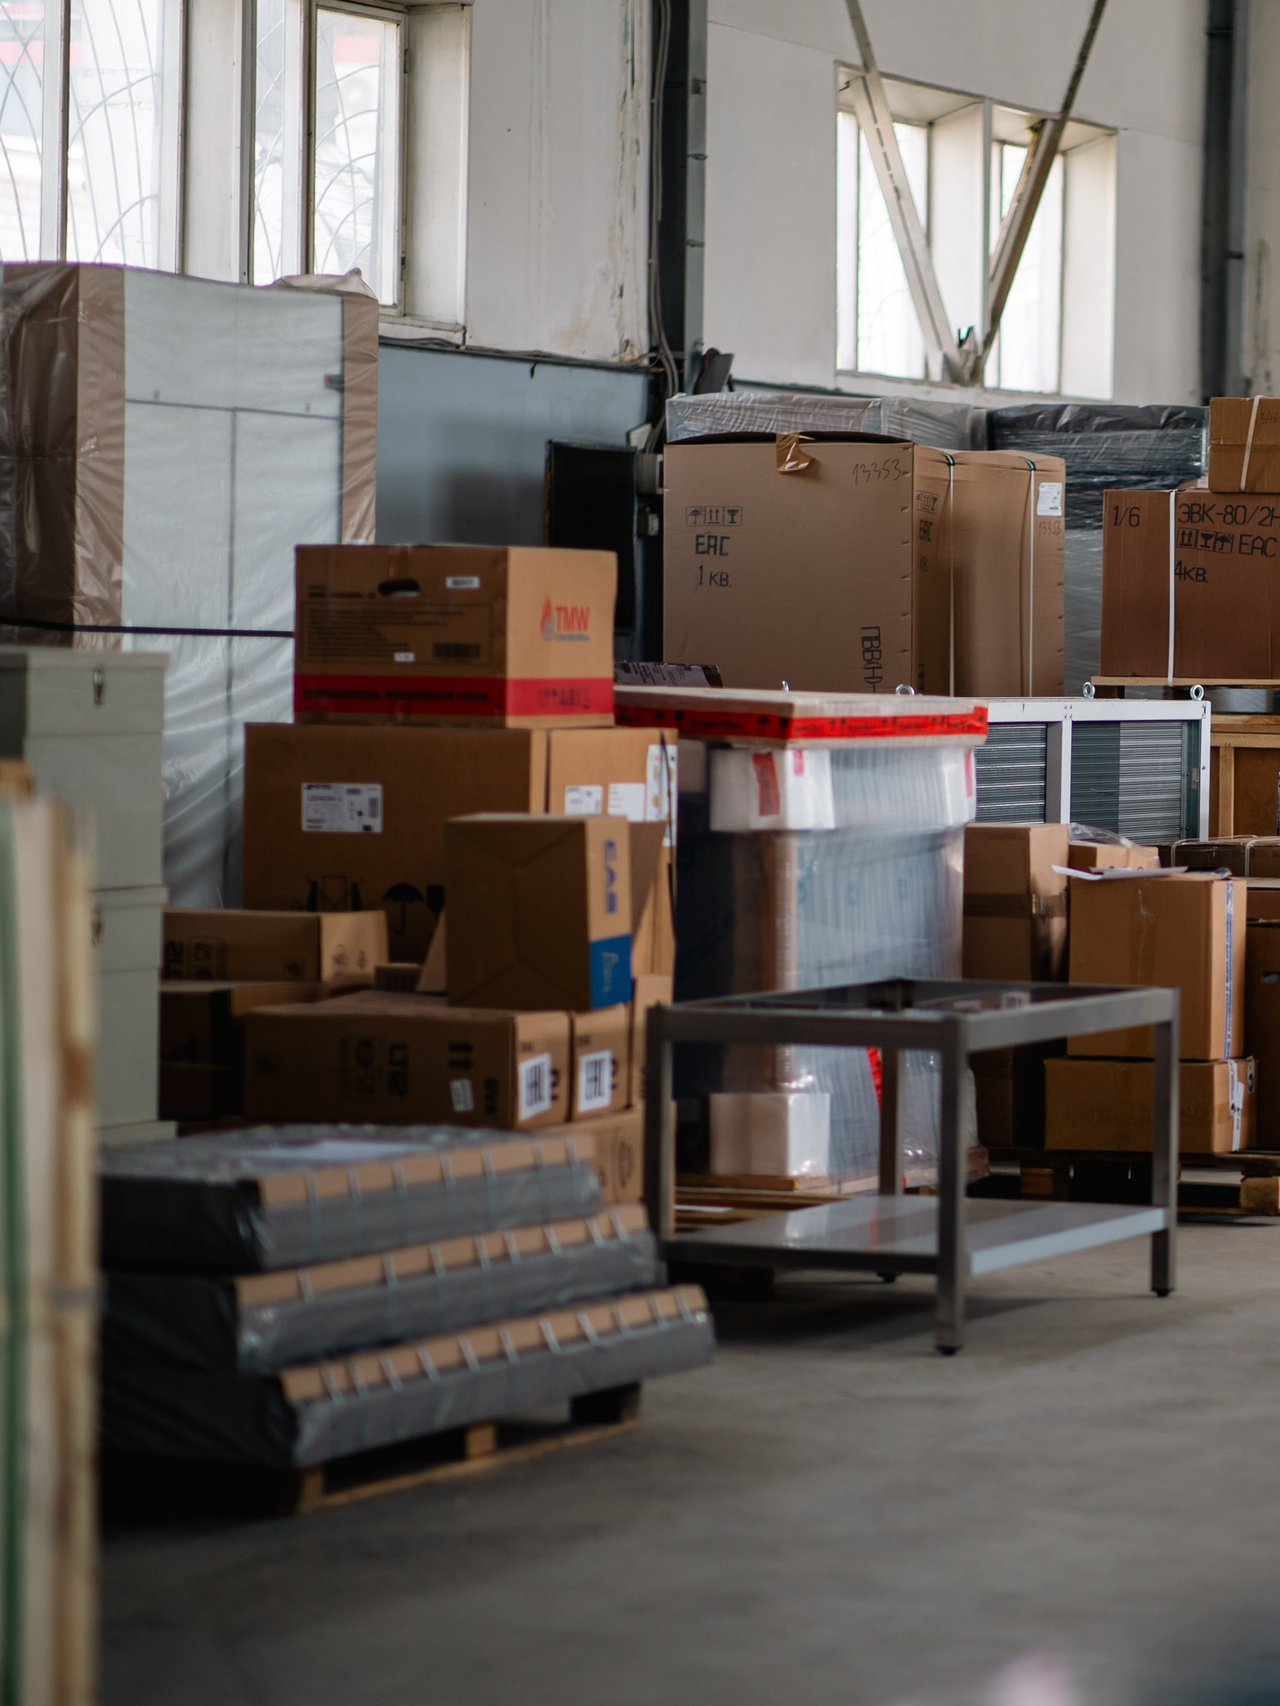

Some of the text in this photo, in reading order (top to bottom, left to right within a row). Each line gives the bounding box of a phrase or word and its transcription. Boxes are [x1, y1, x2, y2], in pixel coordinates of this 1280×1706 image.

[1112, 506, 1141, 528] 1/6
[695, 534, 731, 557] EAC
[1238, 533, 1279, 558] EAC
[555, 605, 590, 632] TMW
